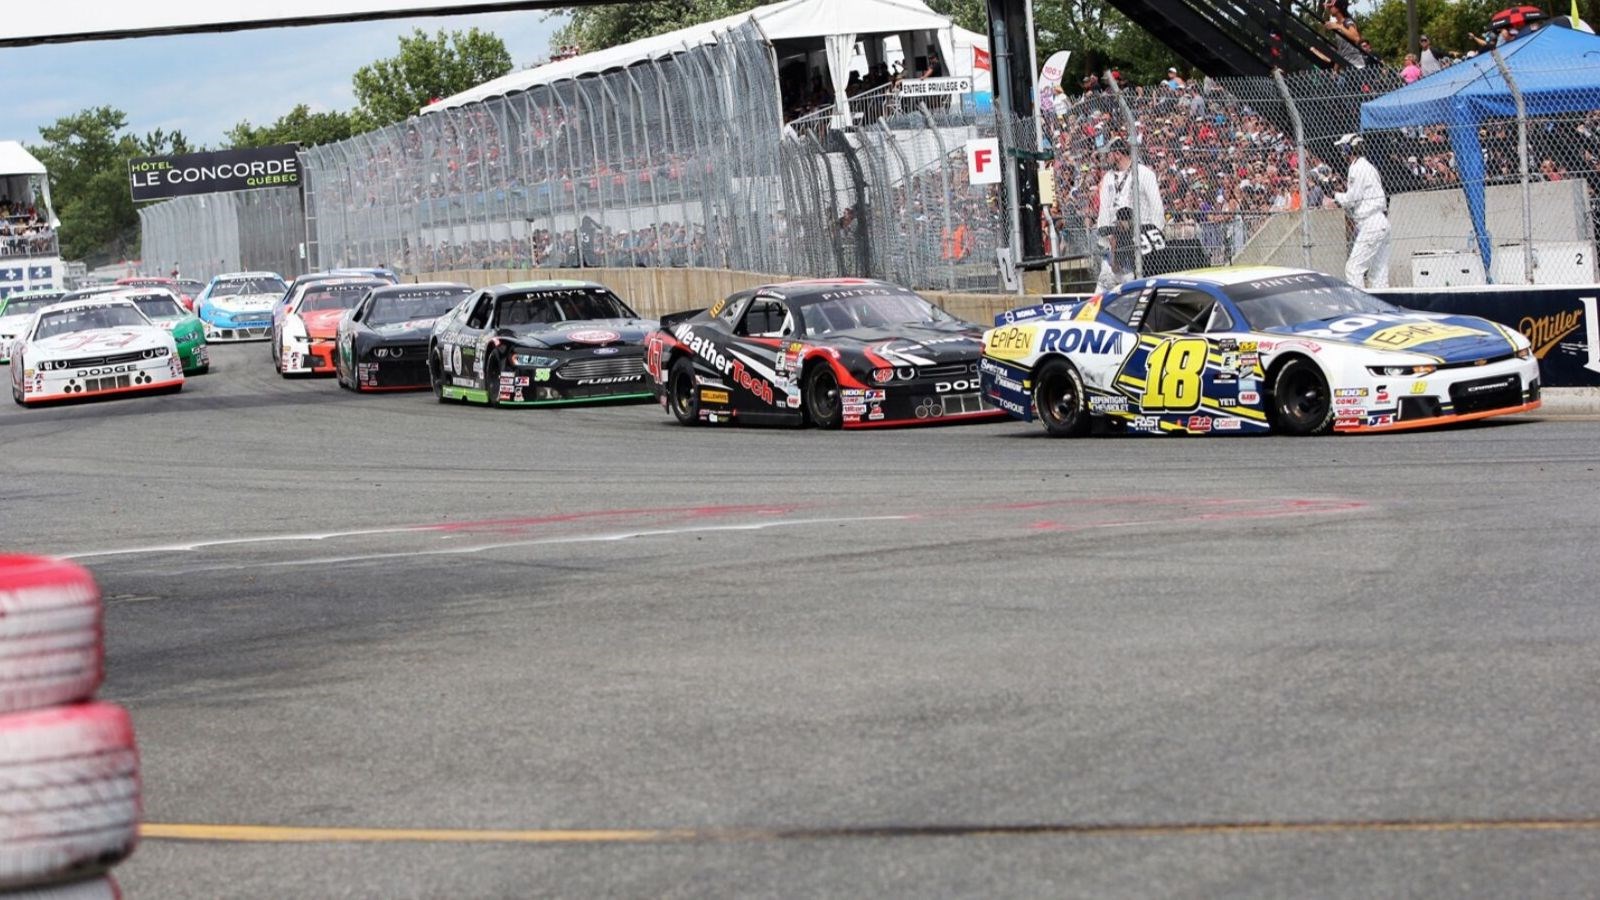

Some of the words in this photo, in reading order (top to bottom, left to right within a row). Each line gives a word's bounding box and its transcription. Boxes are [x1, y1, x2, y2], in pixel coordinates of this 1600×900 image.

[132, 161, 173, 172] HÔTEL
[975, 149, 992, 172] F
[132, 171, 161, 187] LE
[167, 158, 297, 184] CONCORDE
[1576, 253, 1583, 265] 2
[1251, 274, 1316, 290] PINTY'S
[399, 291, 452, 299] PINTY'S
[527, 289, 586, 299] PINTY'S
[821, 289, 890, 300] PINTY'S
[1519, 309, 1582, 351] Miller
[1039, 328, 1122, 354] RONA
[77, 364, 138, 377] DODGE
[674, 323, 773, 405] WeatherTech
[577, 374, 642, 385] FUSION
[1140, 337, 1210, 413] 18
[999, 399, 1025, 414] TORQUE
[1219, 398, 1236, 406] YETI
[1134, 416, 1160, 427] FAST
